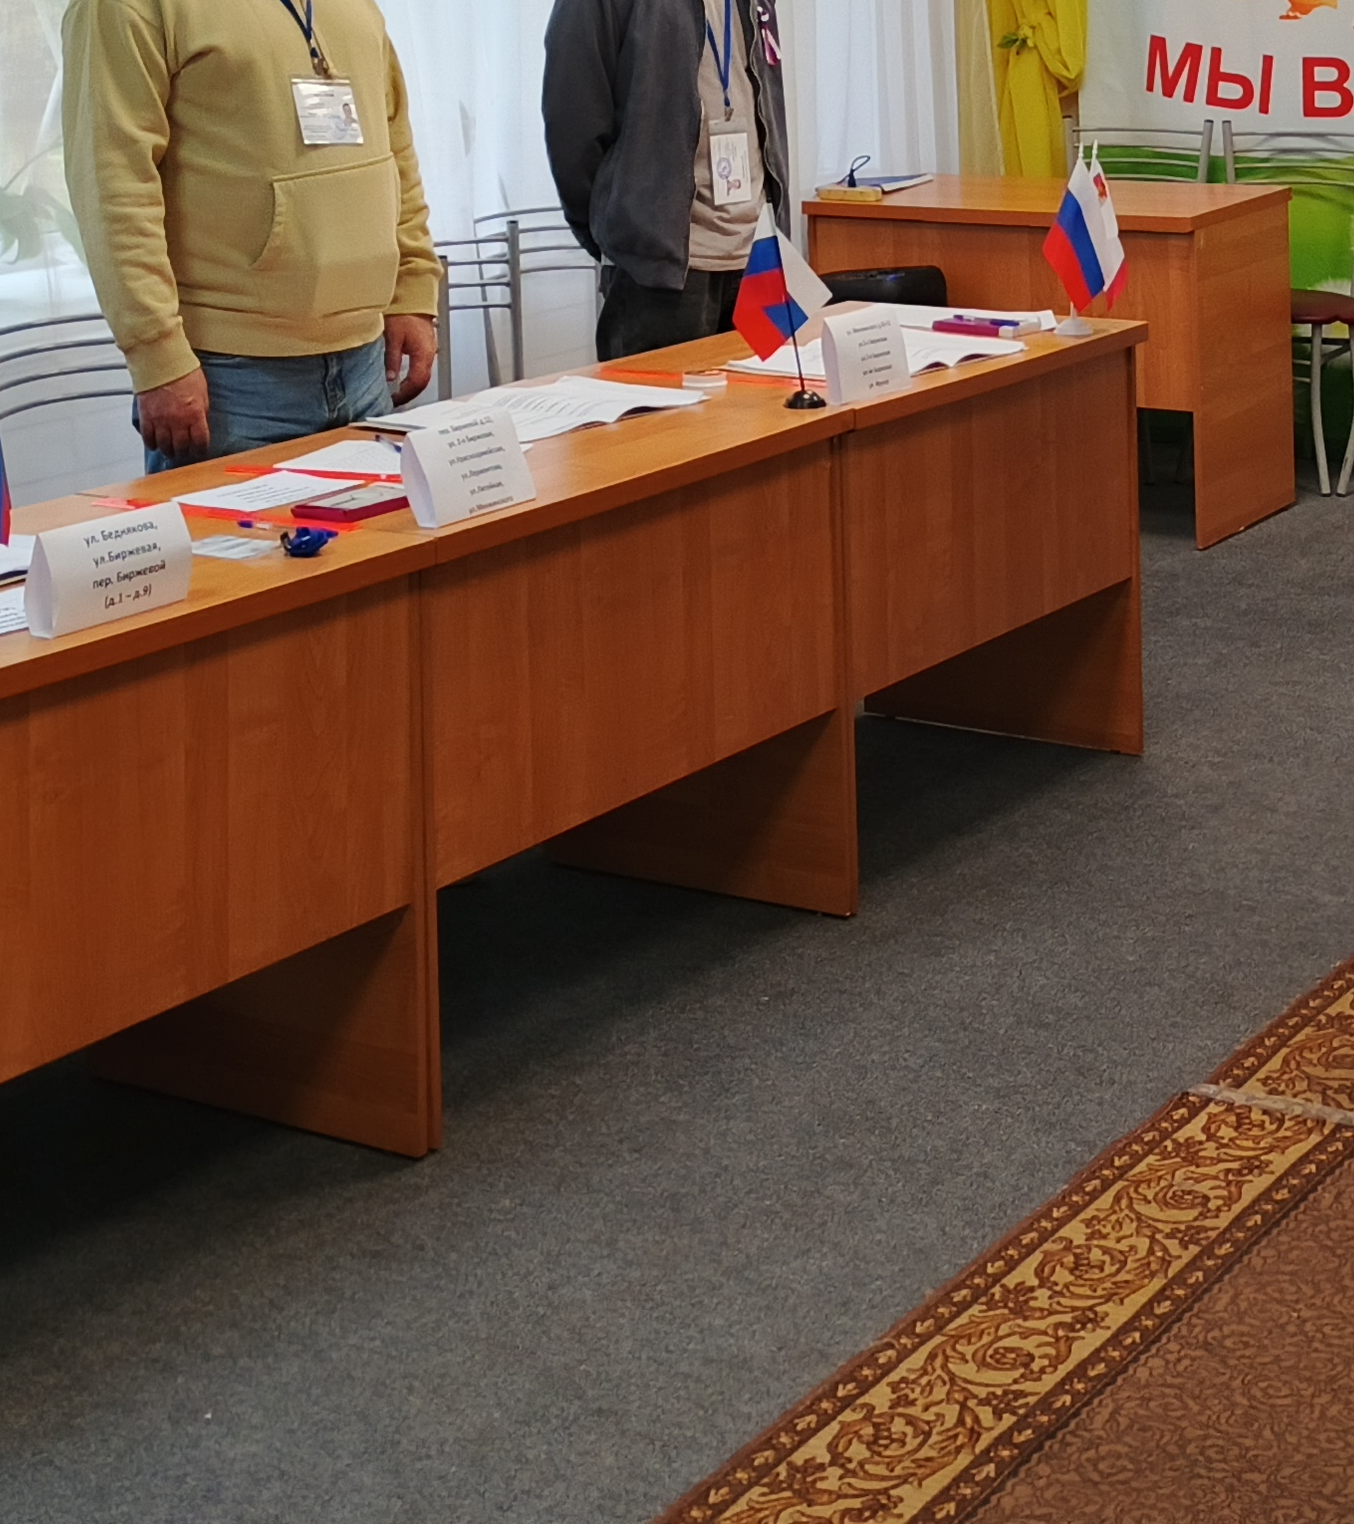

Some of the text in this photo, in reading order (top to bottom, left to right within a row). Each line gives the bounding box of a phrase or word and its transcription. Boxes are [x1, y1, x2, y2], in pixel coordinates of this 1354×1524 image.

[1146, 34, 1274, 115] МЫ
[83, 535, 99, 548] ул.
[116, 559, 166, 582] Биржевой
